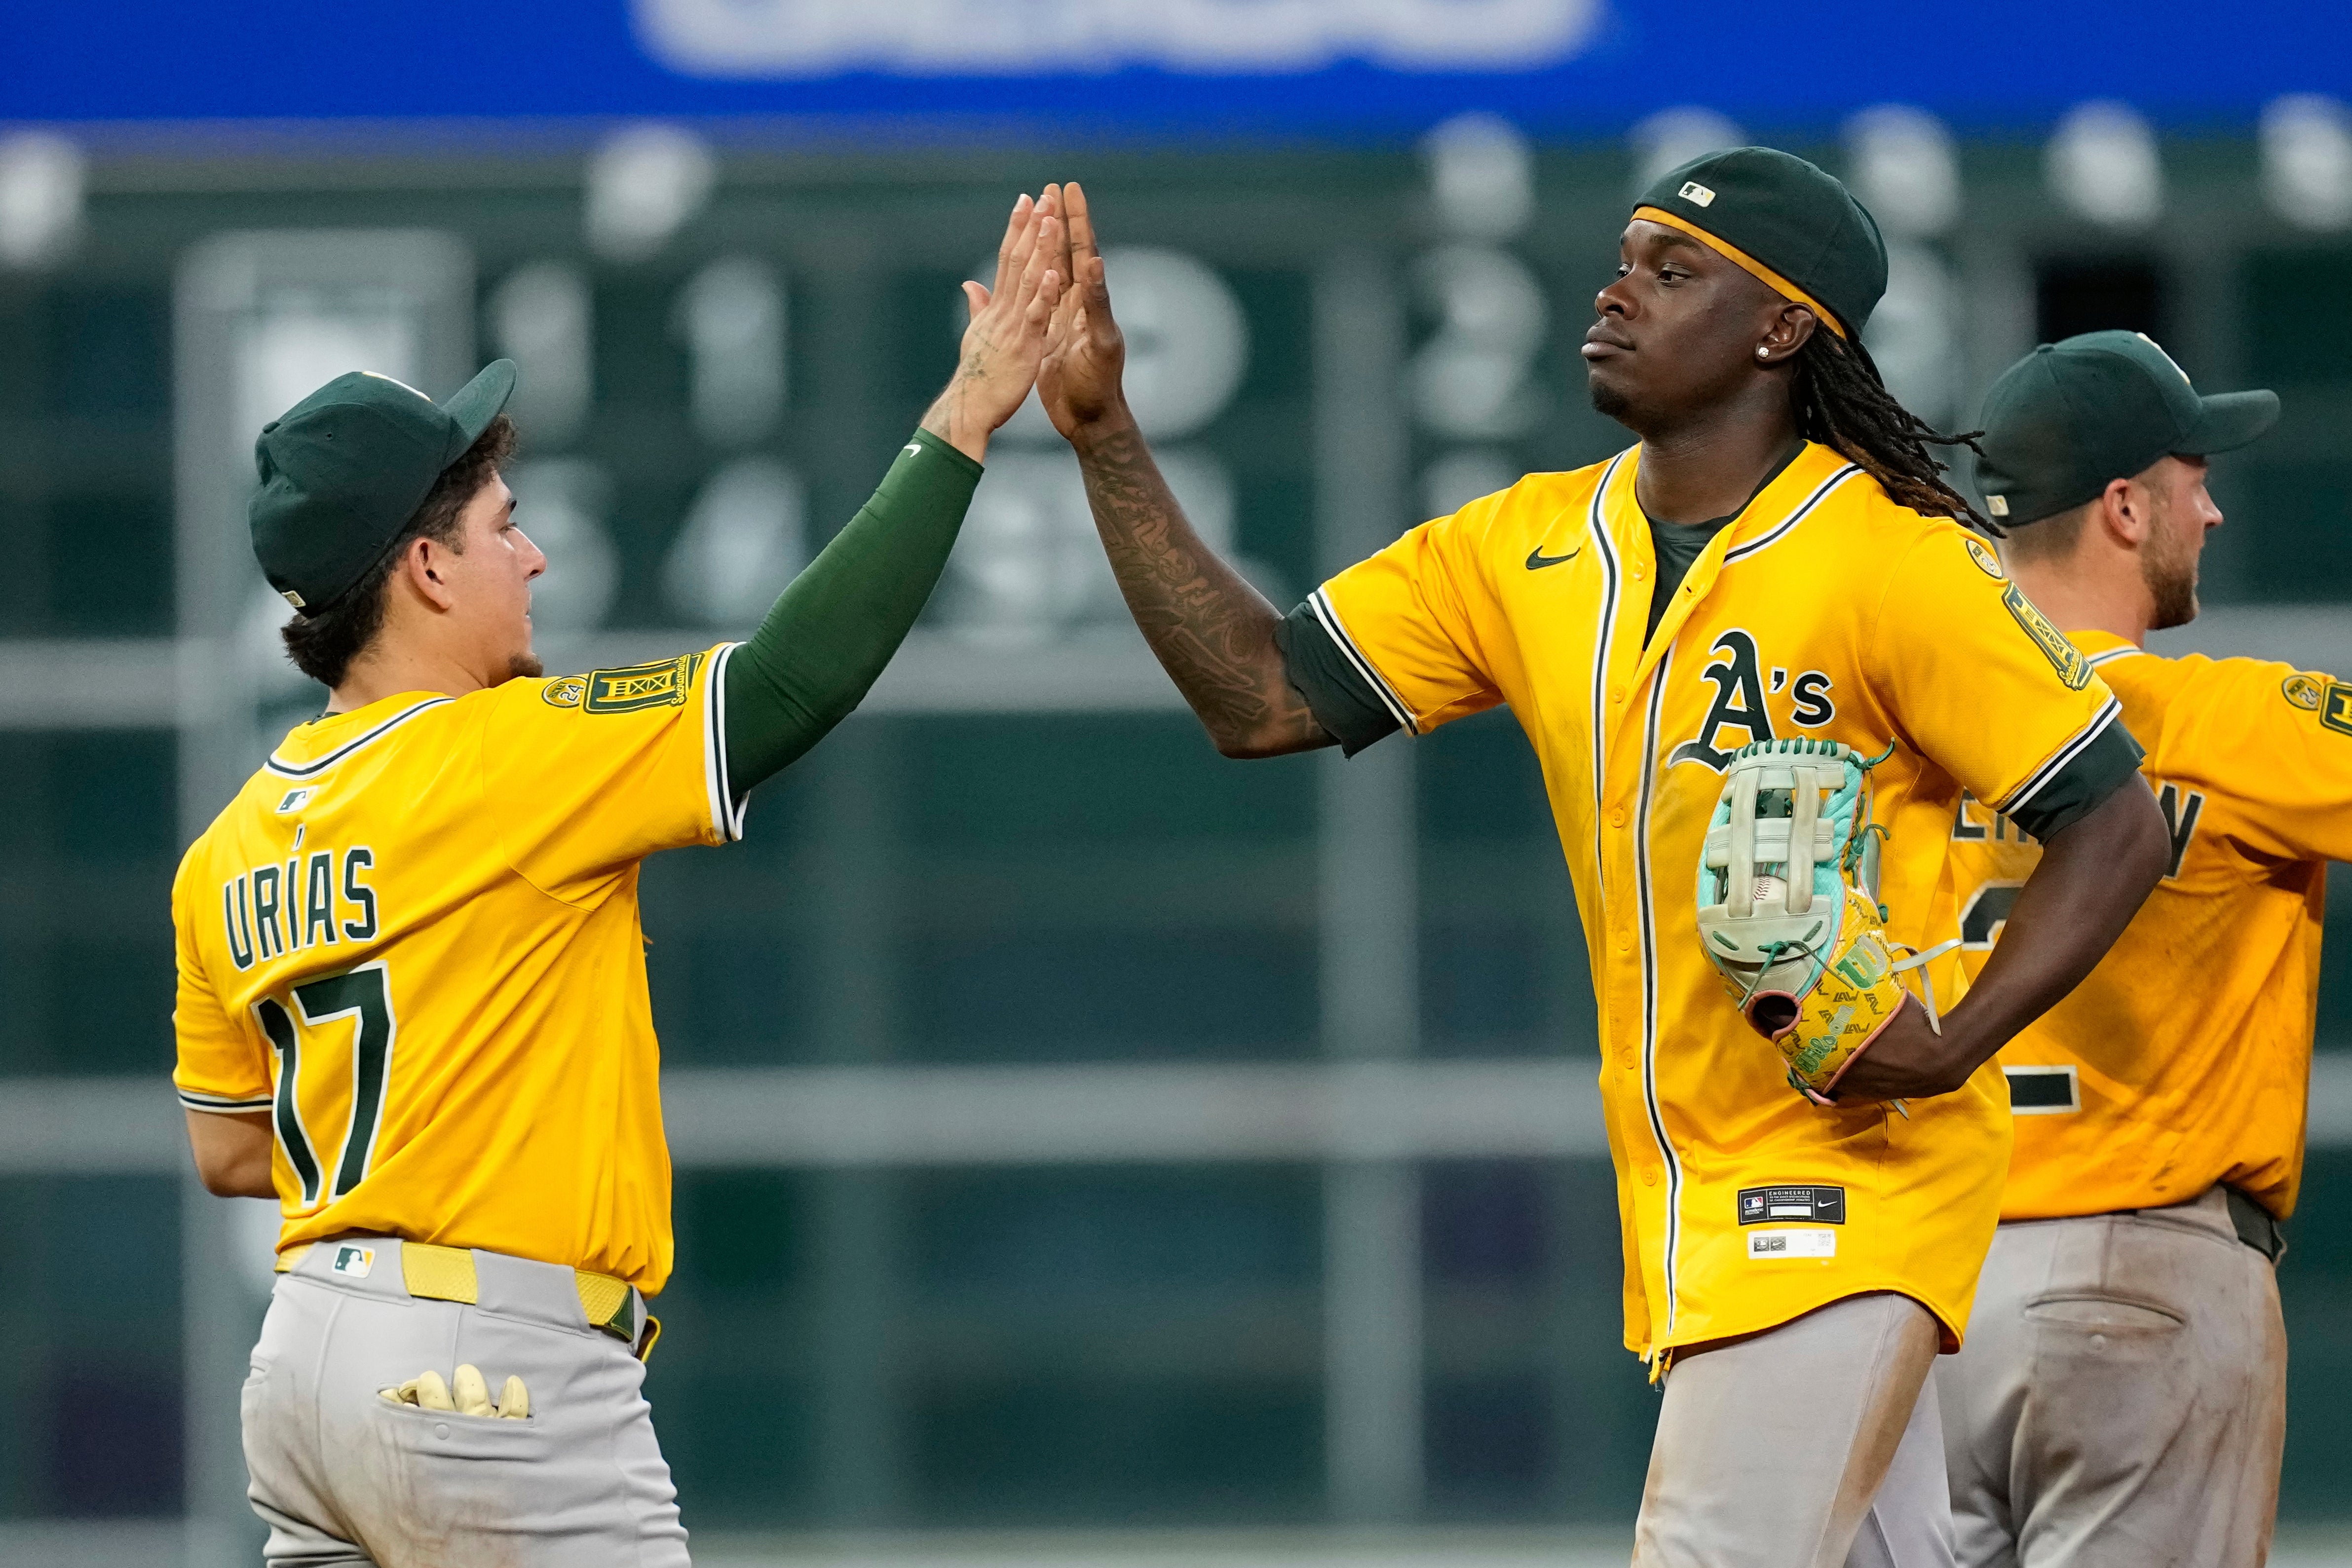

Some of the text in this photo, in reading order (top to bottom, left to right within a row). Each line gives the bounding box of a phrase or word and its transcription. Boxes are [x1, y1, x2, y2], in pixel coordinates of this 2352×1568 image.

[560, 683, 584, 702] 24
[672, 654, 687, 705] Sacramento
[1666, 627, 1835, 776] A's
[224, 823, 379, 972] URÍAS
[1833, 991, 1860, 1002] LAW
[251, 959, 396, 1209] 17
